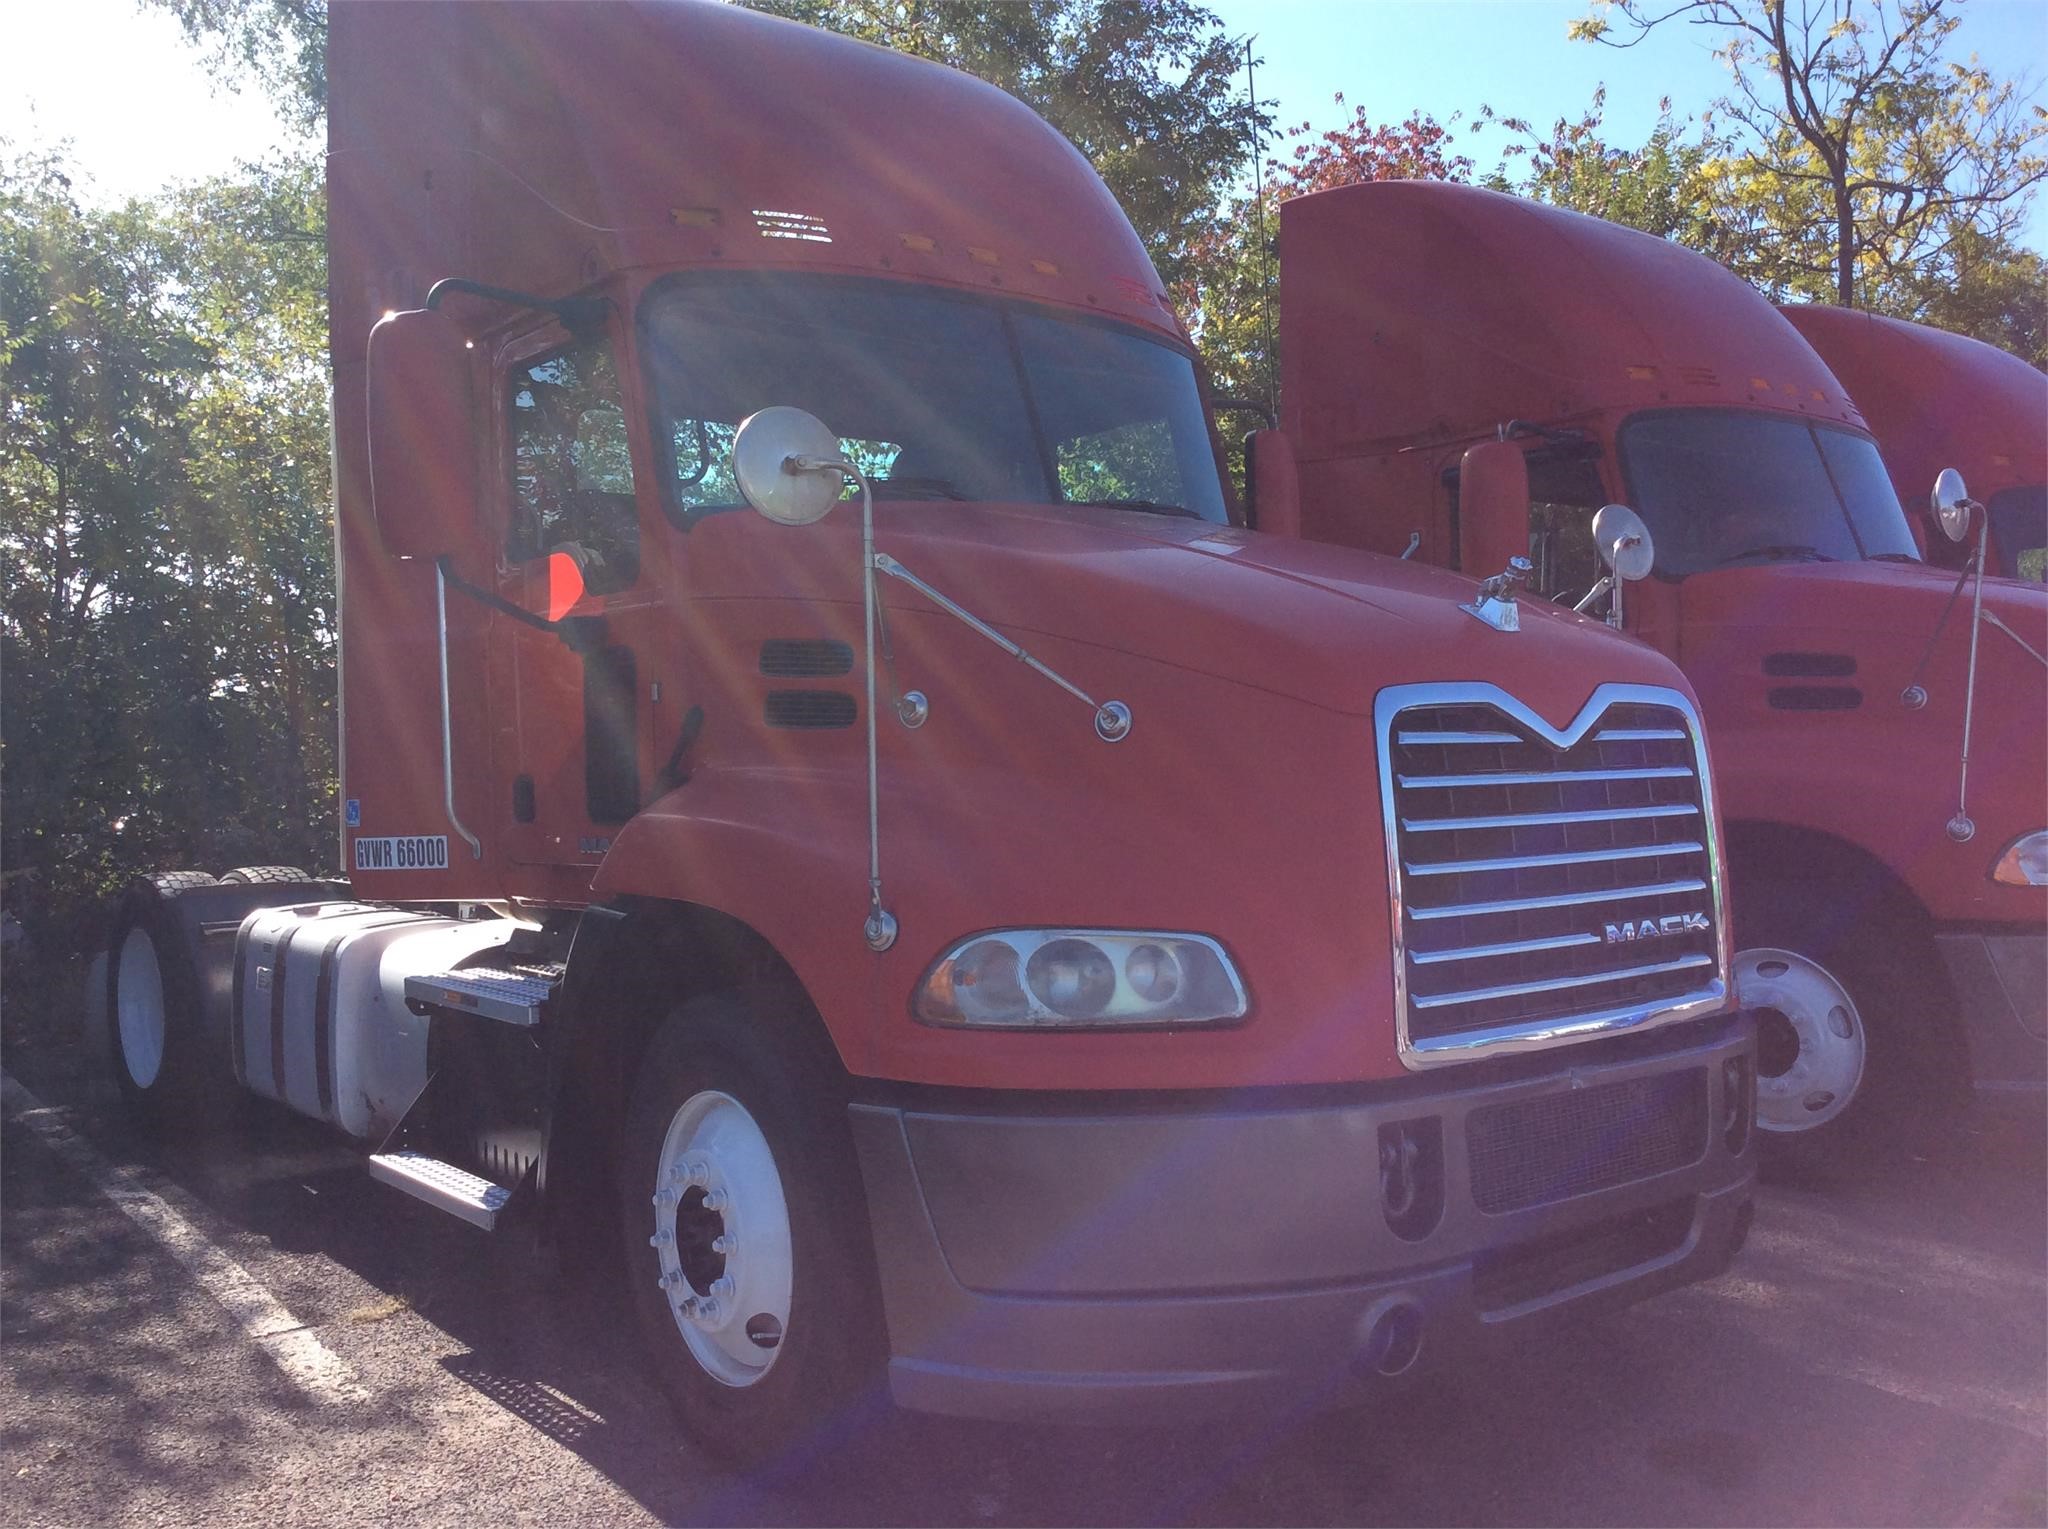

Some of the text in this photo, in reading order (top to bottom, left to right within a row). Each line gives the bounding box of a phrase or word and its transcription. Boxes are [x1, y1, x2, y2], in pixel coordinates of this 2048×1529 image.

[357, 838, 446, 868] GVWR 66000
[1605, 912, 1710, 943] MACK
